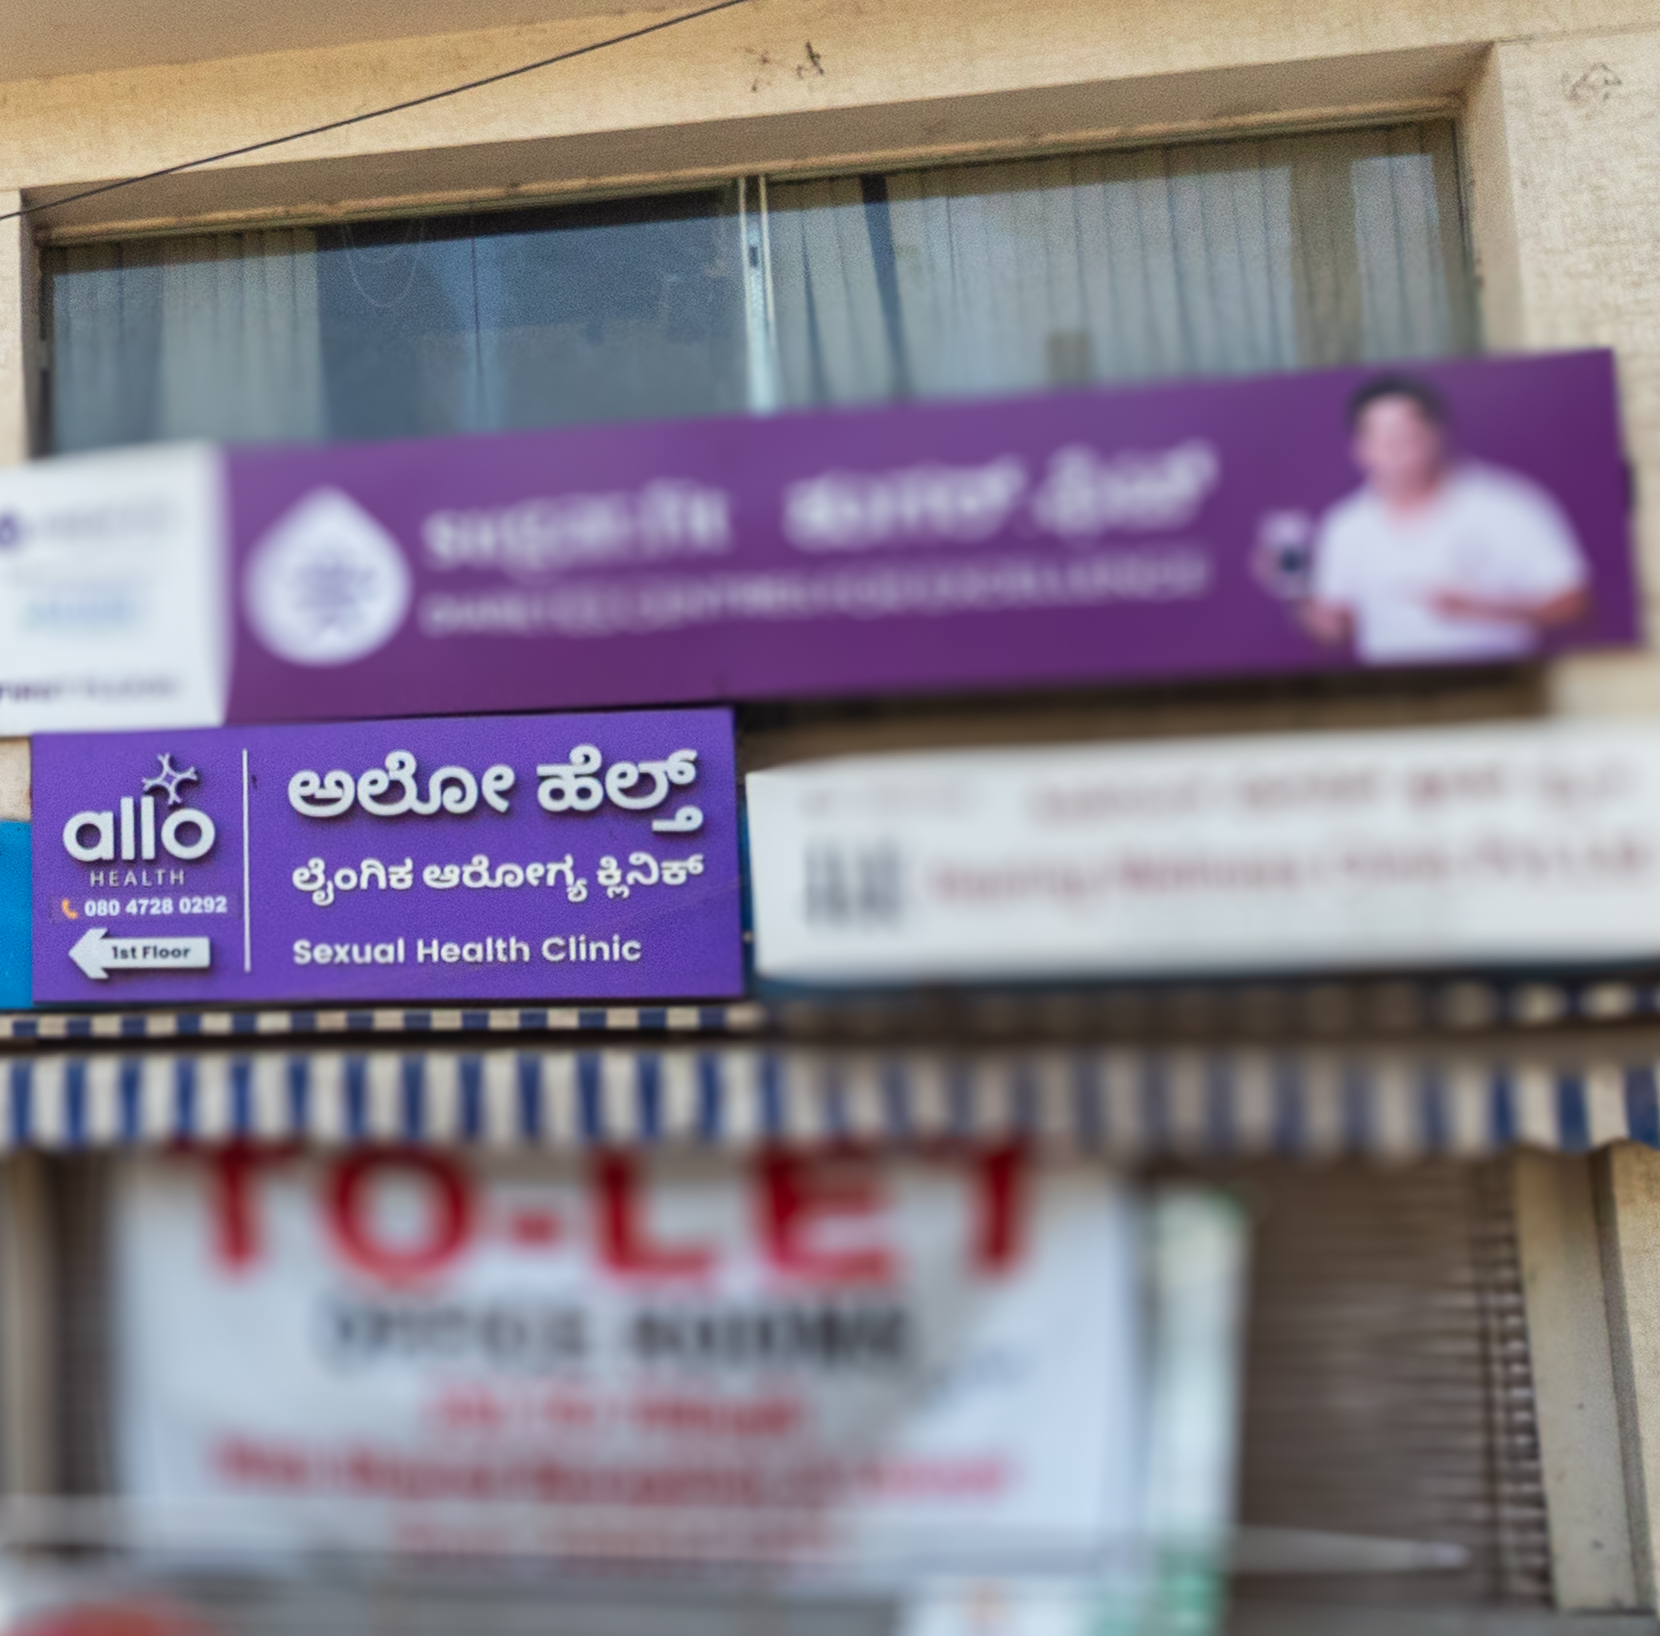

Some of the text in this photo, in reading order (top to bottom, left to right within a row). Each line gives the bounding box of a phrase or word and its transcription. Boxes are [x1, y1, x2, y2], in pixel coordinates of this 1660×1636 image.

[287, 749, 515, 817] ಅಲೋ
[62, 795, 216, 862] allo
[89, 868, 185, 887] HEALTH
[422, 852, 588, 903] ಆರೋಗ್ಯ
[84, 895, 228, 917] 080 4728 0292
[112, 944, 192, 960] 1st Floor
[292, 933, 642, 965] Sexual Health Clinic
